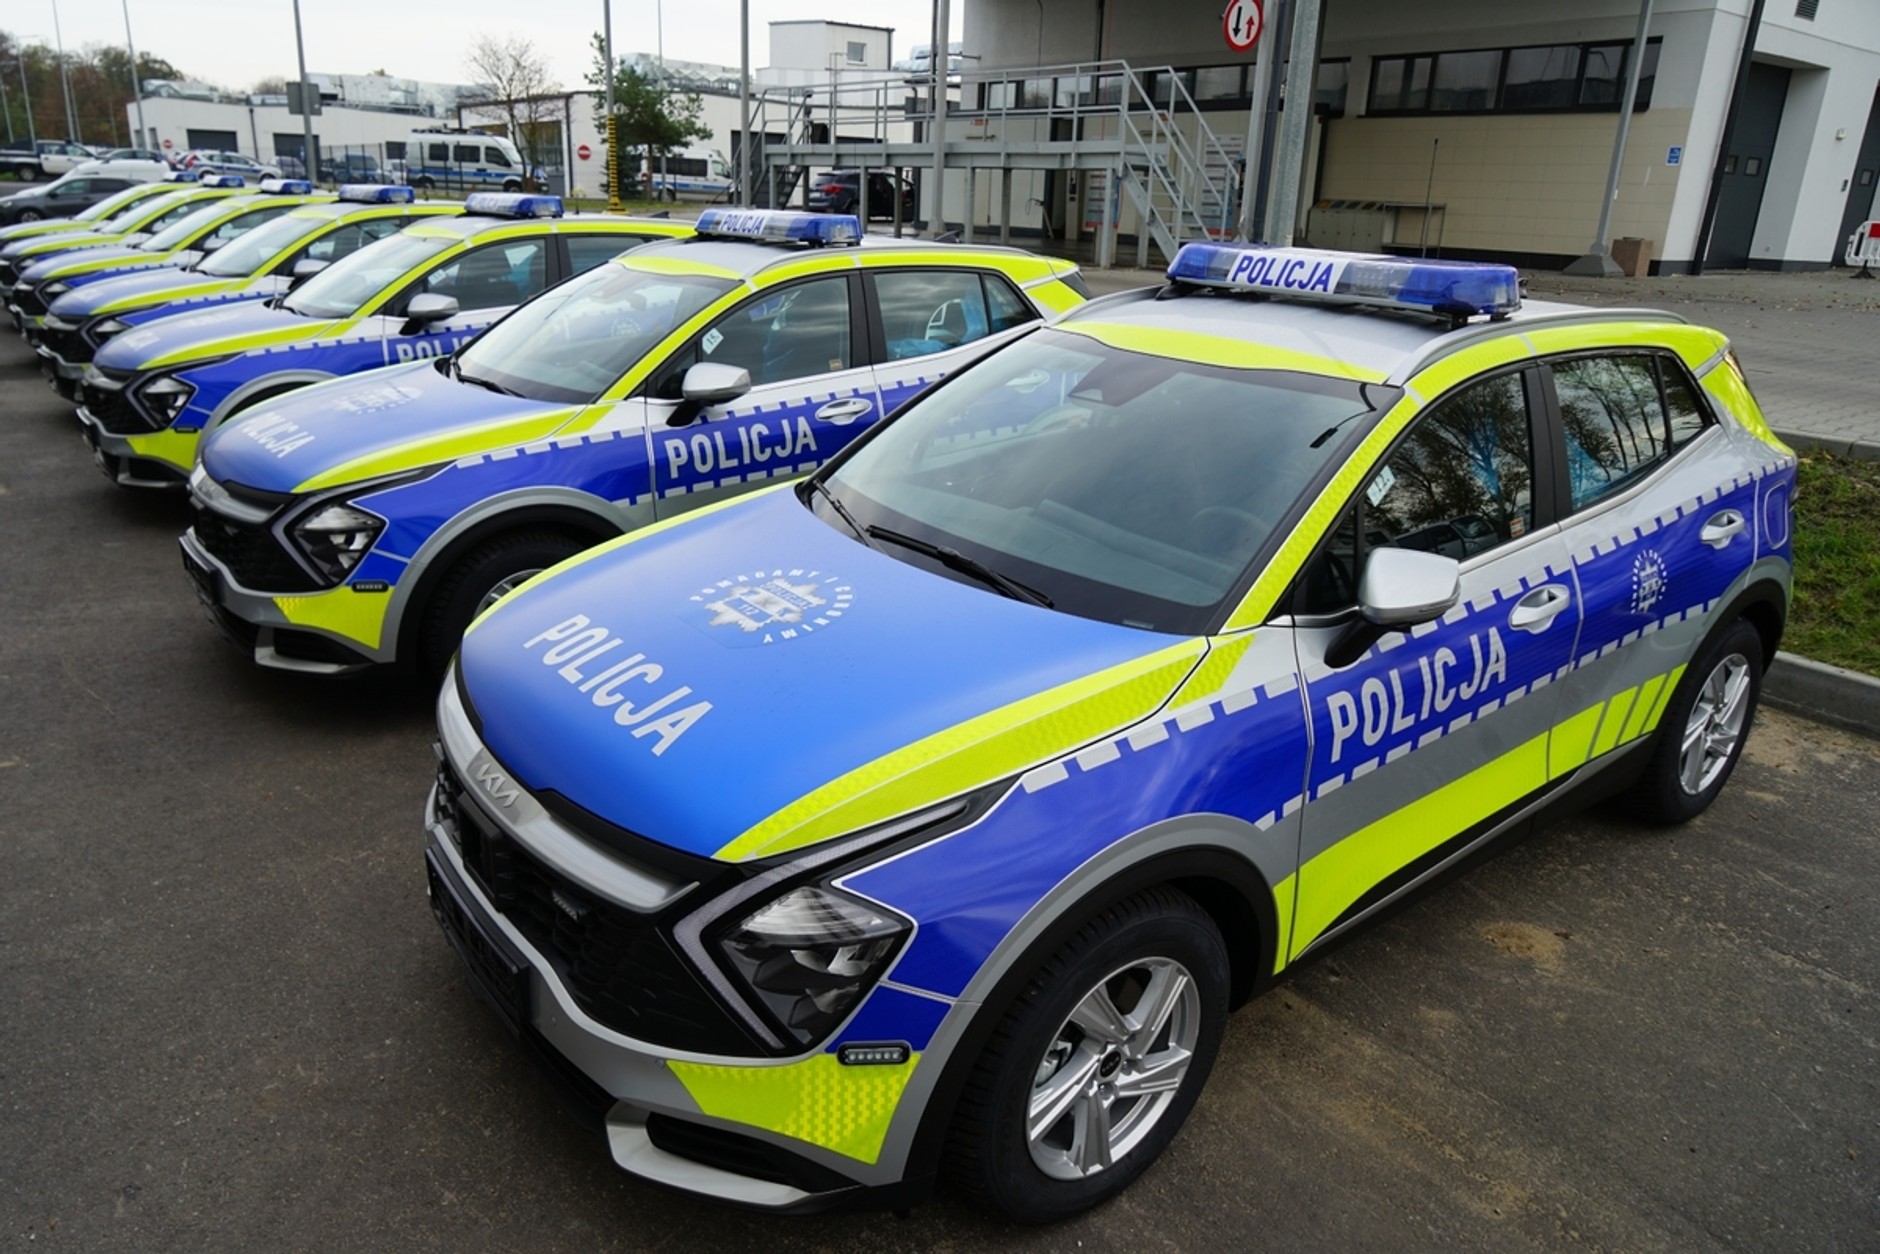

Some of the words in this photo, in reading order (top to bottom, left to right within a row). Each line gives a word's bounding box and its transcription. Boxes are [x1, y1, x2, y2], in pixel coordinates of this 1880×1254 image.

[721, 213, 765, 235] POLICJA
[1233, 252, 1337, 293] POLICJA
[664, 415, 818, 479] POLICJA
[737, 603, 761, 616] 112
[522, 614, 714, 757] POLICJA
[1326, 626, 1507, 763] POLICJA
